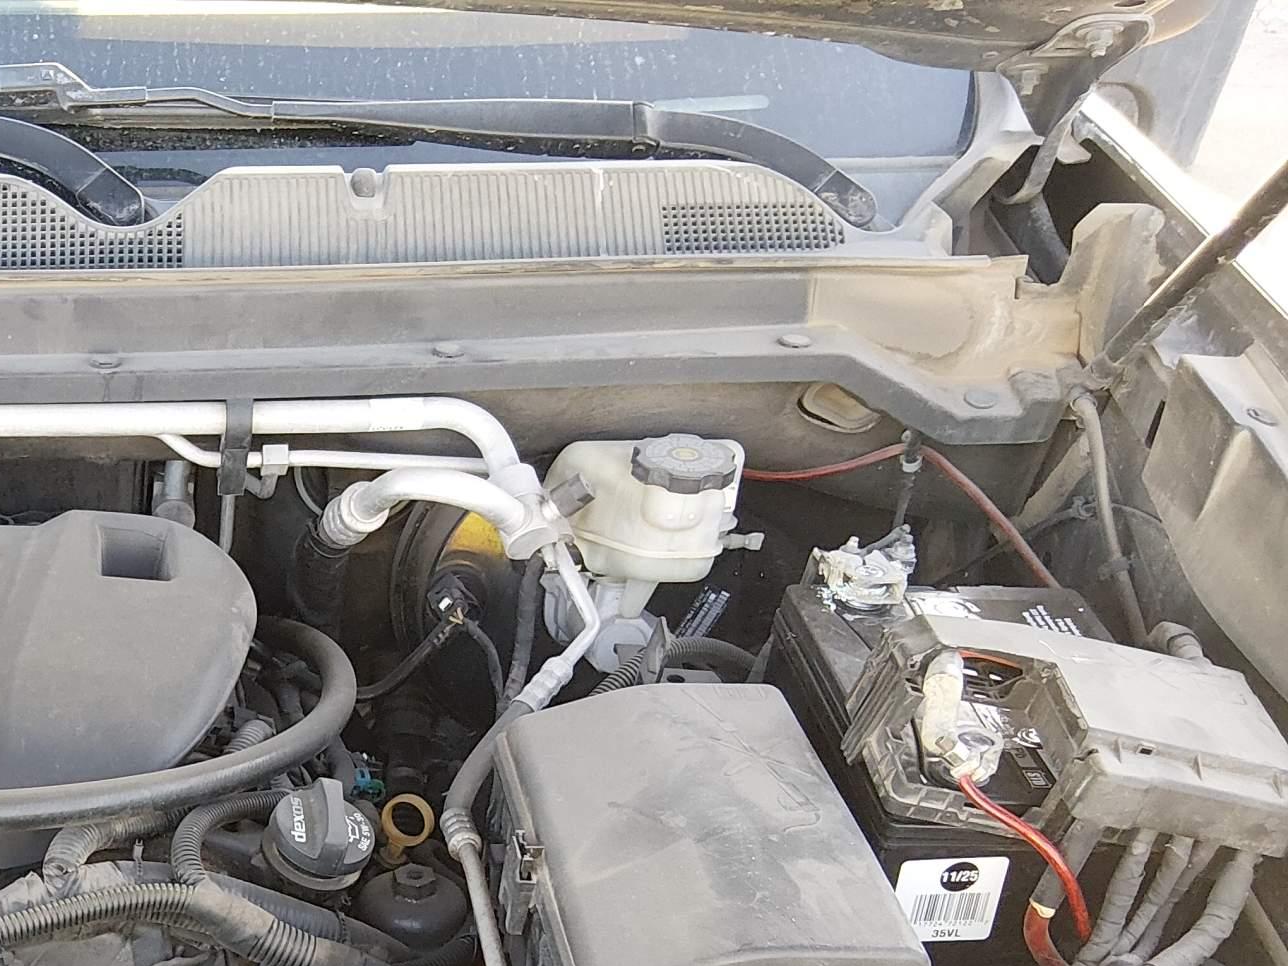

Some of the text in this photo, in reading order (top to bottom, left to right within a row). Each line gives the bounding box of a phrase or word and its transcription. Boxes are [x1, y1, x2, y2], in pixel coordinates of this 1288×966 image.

[290, 796, 307, 843] dexos
[357, 837, 371, 851] SAE
[941, 870, 979, 882] 11/25
[931, 929, 961, 938] 35VL
